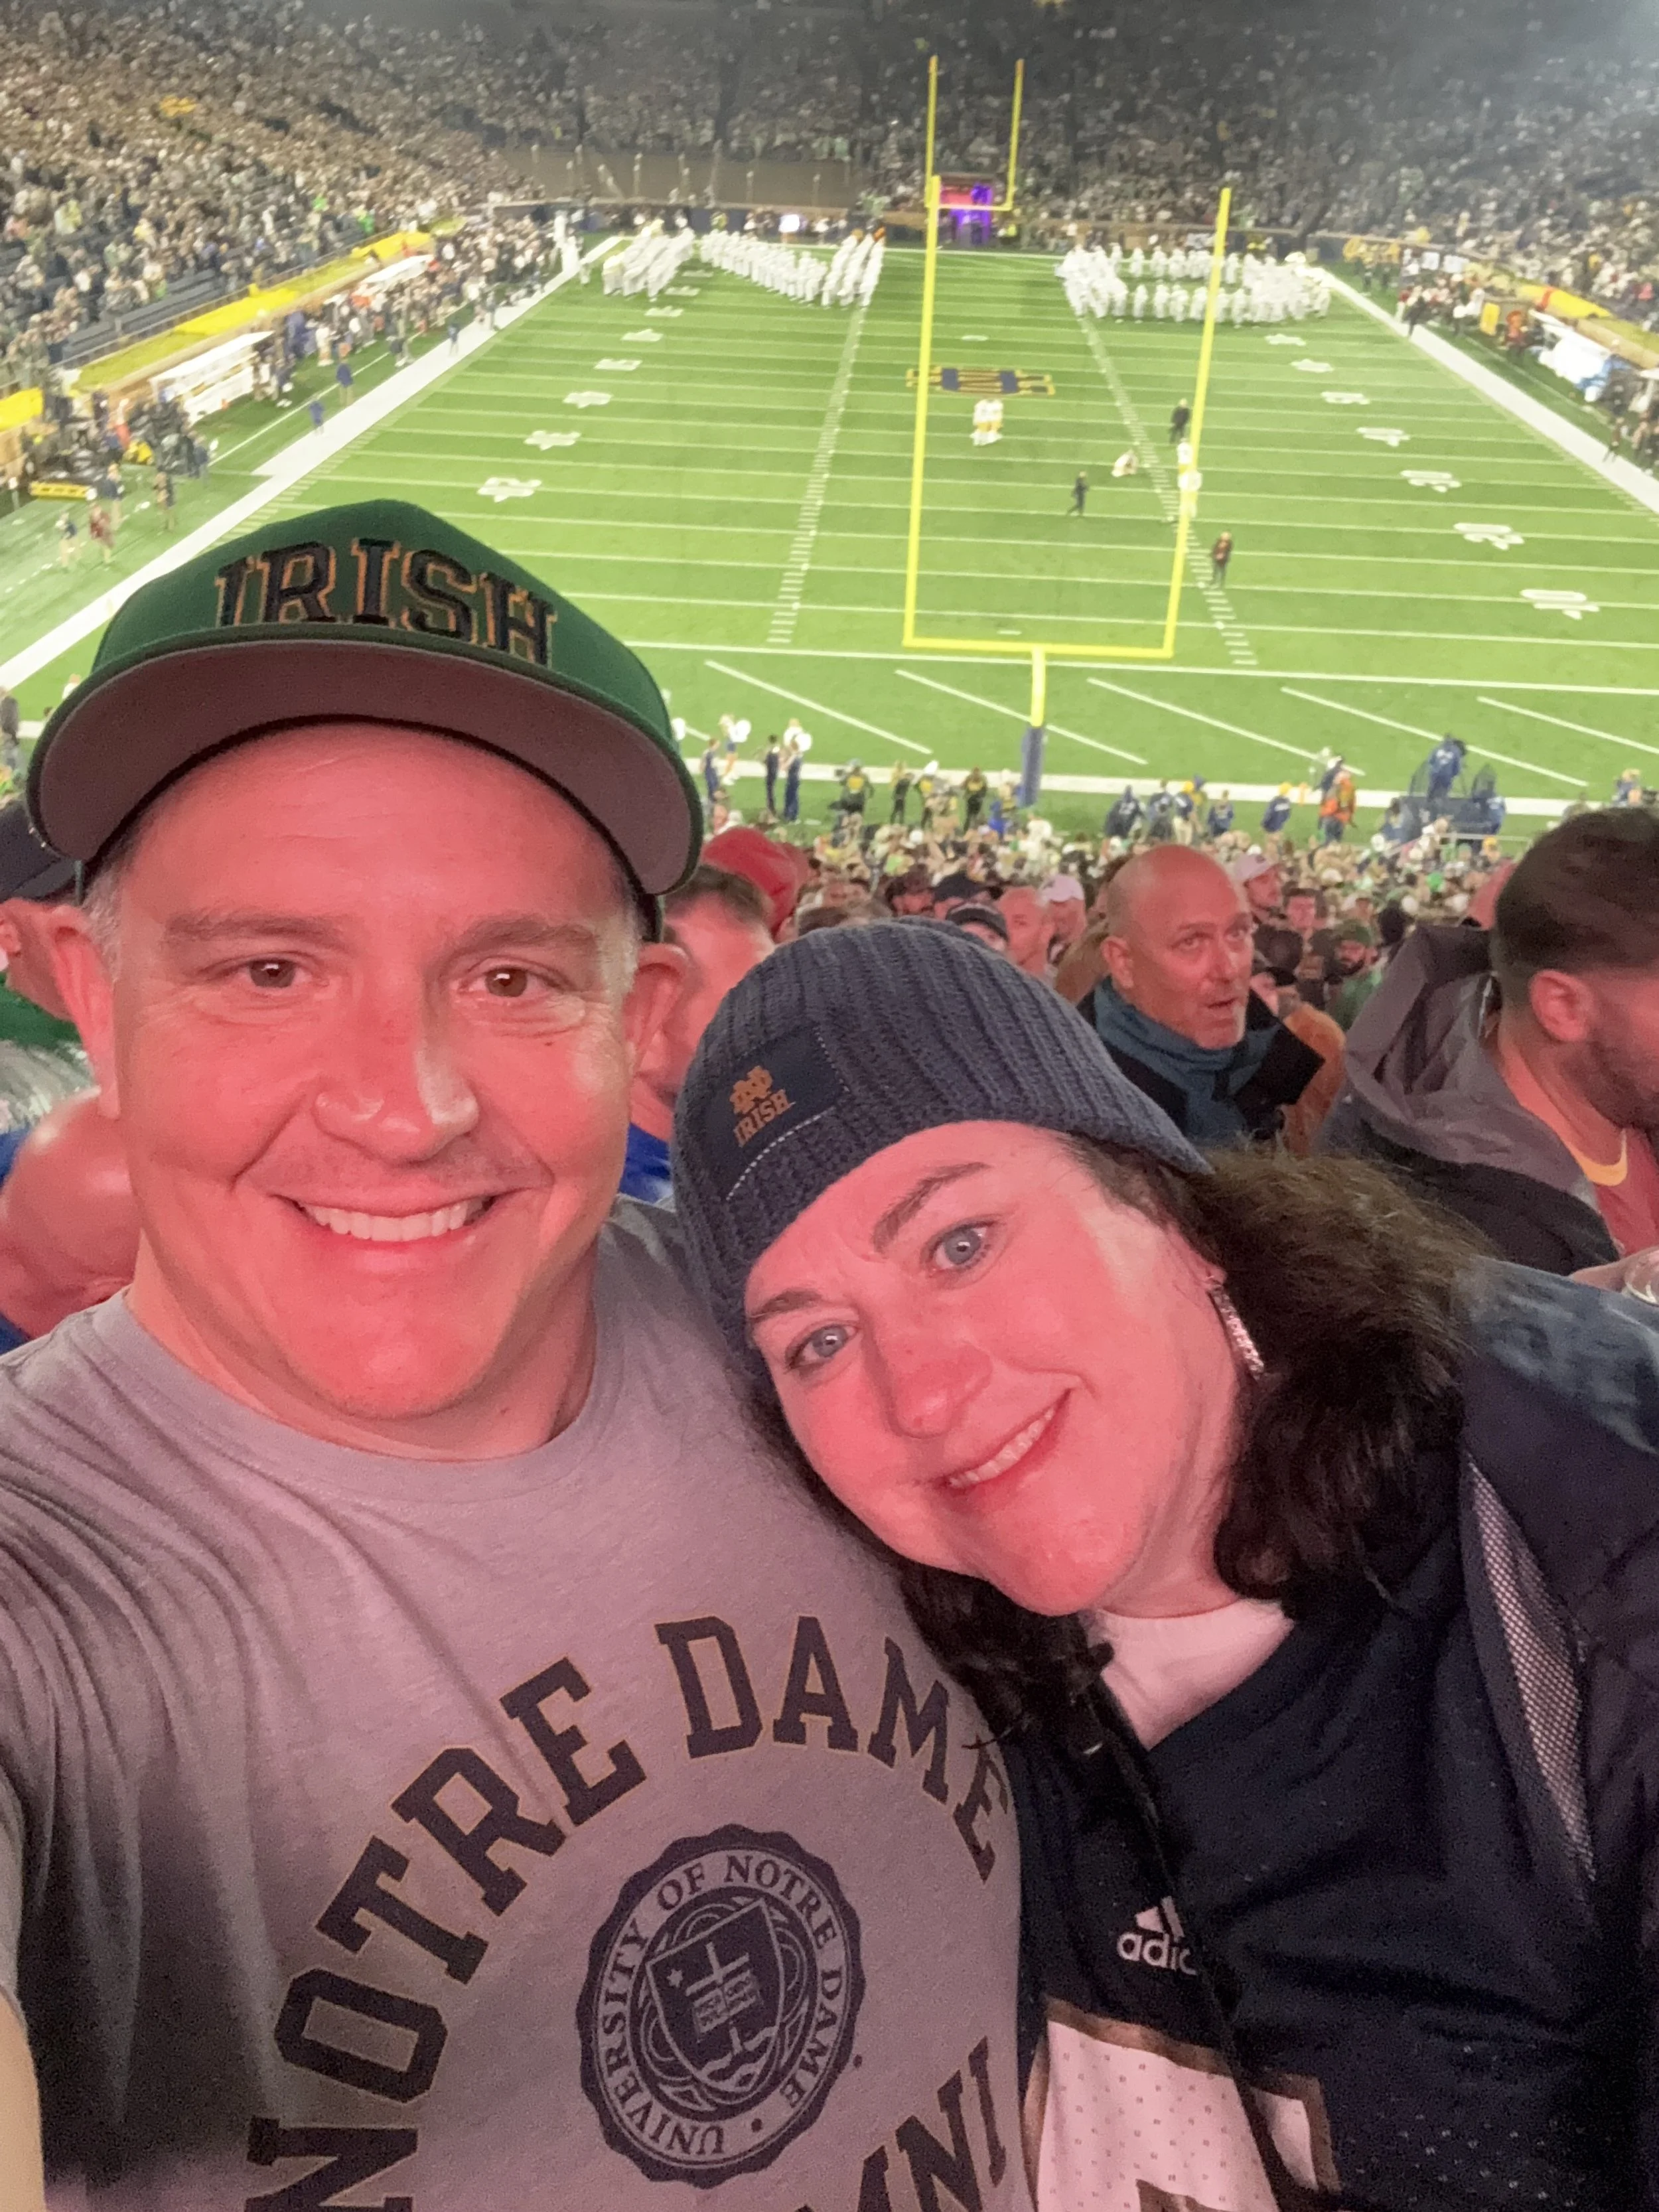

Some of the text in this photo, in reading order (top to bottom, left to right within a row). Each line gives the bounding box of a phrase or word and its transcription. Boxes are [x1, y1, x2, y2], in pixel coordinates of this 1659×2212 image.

[215, 537, 558, 667] IRISH
[733, 1088, 795, 1147] IRISH
[244, 1657, 646, 2212] NOTRE
[656, 1616, 1011, 1883] DAME
[602, 1855, 842, 2154] UNIVERSITY OF NOTRE DAME
